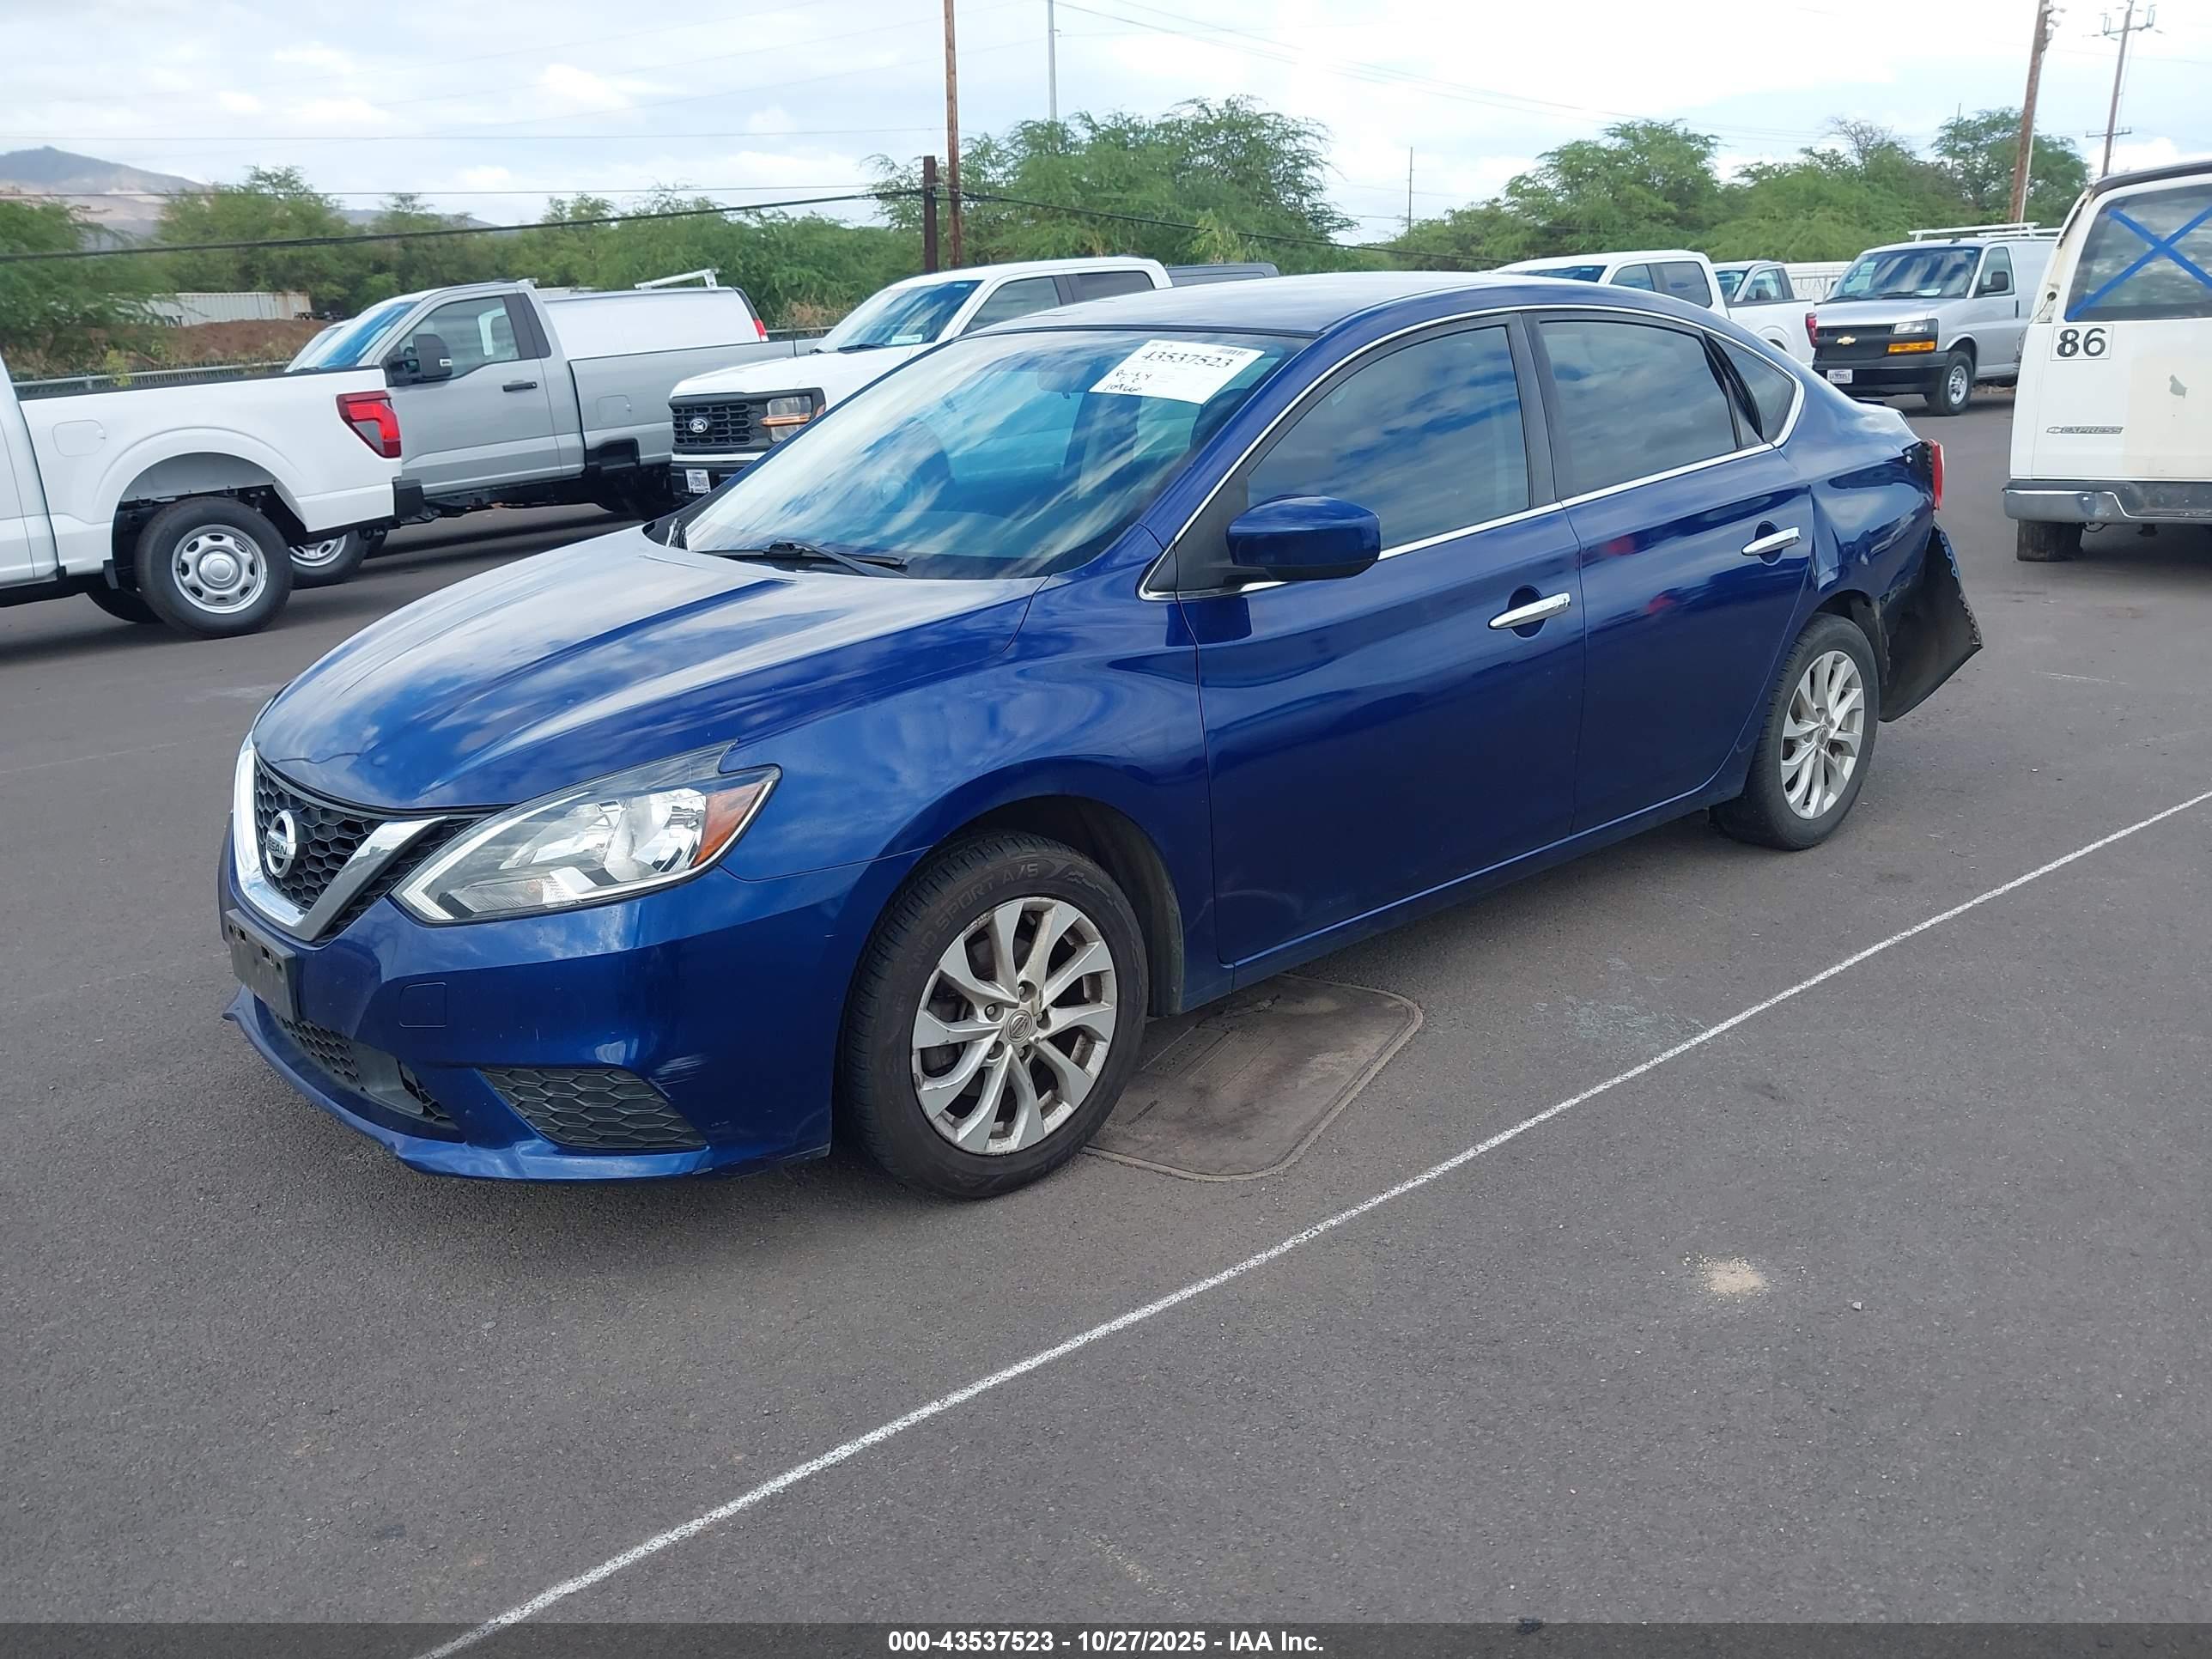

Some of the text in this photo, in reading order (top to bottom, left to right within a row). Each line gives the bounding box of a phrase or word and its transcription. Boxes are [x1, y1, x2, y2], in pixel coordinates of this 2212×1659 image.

[2057, 327, 2106, 358] 86
[1142, 350, 1234, 368] 43537523
[2062, 425, 2123, 434] EXPRESS
[934, 874, 995, 931] SPORT
